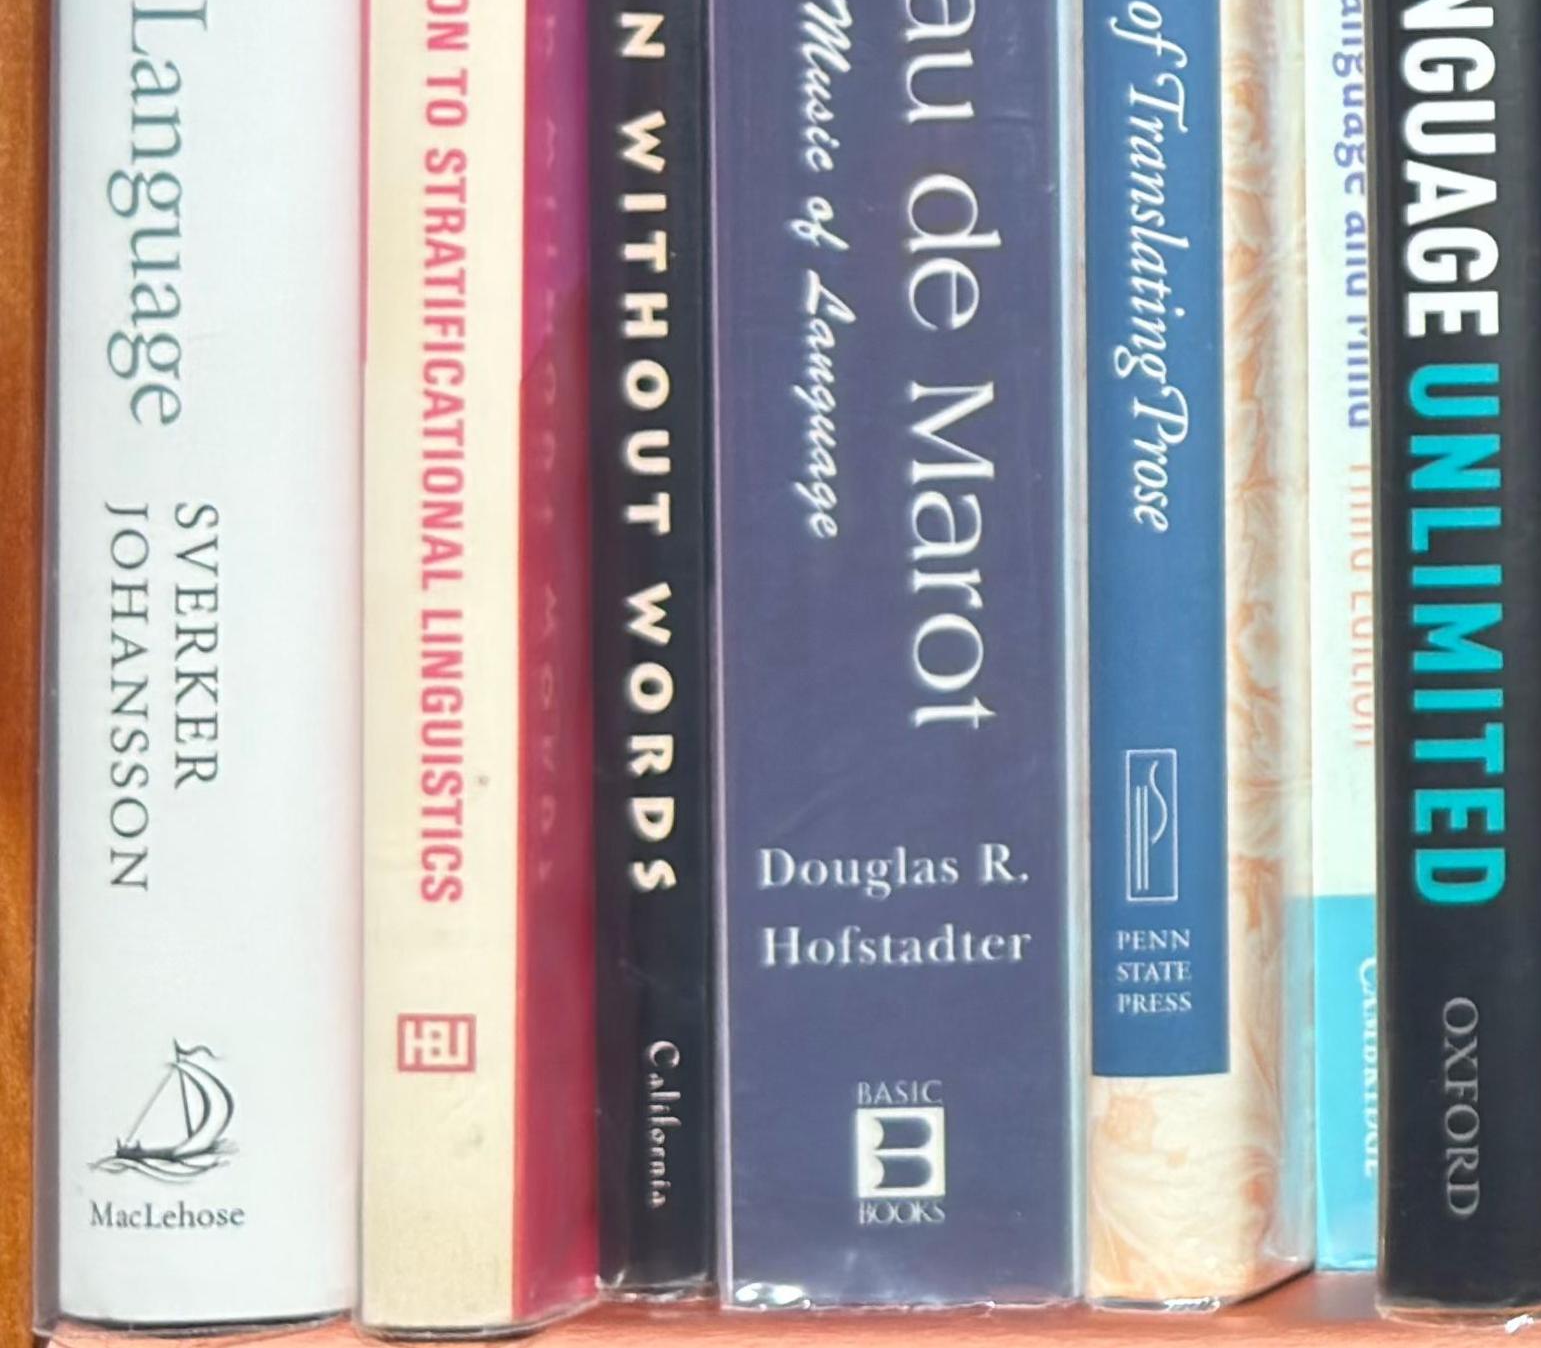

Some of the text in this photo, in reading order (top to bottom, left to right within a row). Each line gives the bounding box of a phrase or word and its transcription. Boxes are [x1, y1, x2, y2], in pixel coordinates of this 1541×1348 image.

[424, 69, 469, 128] TO
[1110, 1, 1188, 66] of
[107, 0, 208, 428] Language
[785, 195, 848, 250] of
[907, 173, 1001, 332] de
[1113, 72, 1190, 382] Translating
[421, 148, 468, 592] STRATIFICATIONAL
[621, 111, 672, 536] WITHOUT
[792, 268, 856, 538] Language
[1131, 382, 1190, 533] Prose
[910, 381, 995, 730] Marot
[1408, 363, 1507, 904] UNLIMITED
[105, 501, 150, 892] JOHANSSON
[172, 501, 220, 790] SVERKER
[419, 609, 464, 905] LINGUISTICS
[625, 582, 677, 893] WORDS
[758, 843, 1030, 900] Douglas R.
[762, 923, 1031, 969] Hofstadter
[1116, 929, 1191, 951] PENN
[1116, 961, 1192, 983] STATE
[1117, 993, 1193, 1013] PRESS
[857, 1081, 942, 1106] BASIC
[1443, 996, 1480, 1216] OXFORD
[90, 1199, 246, 1230] MacLehose
[859, 1202, 945, 1225] BOOKS
